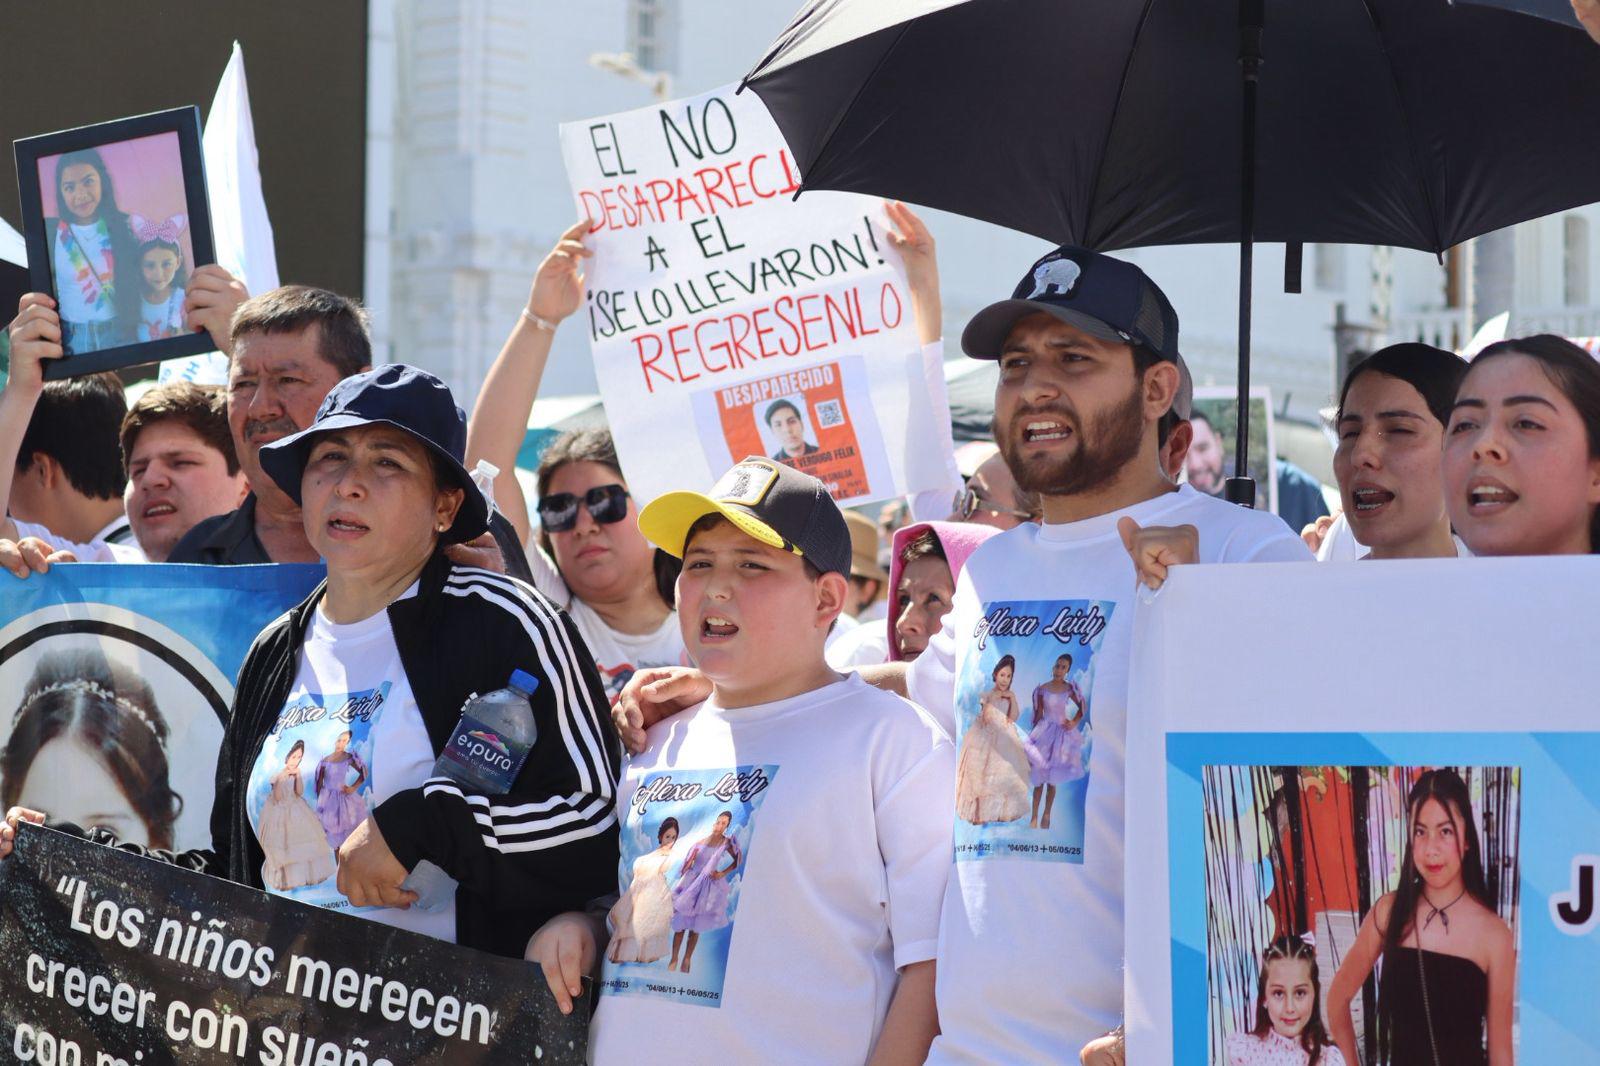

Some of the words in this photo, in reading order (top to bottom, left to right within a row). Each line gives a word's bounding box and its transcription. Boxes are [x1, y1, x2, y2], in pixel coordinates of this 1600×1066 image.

[589, 122, 637, 178] EL
[659, 97, 737, 168] NO
[579, 148, 801, 235] DESAPARECI
[643, 235, 669, 273] A
[690, 214, 746, 259] EL
[630, 282, 902, 393] REGRESENLO
[722, 365, 835, 410] DESAPARECIDO
[974, 606, 1039, 651] Alexa
[1043, 605, 1107, 645] Leidy
[632, 775, 702, 815] Alexa
[704, 768, 769, 803] Leidy
[26, 953, 156, 1029] crecer
[166, 1000, 248, 1058] con
[259, 1026, 394, 1066] sueñ
[153, 910, 275, 987] niños
[286, 954, 490, 1045] merecen
[13, 1022, 82, 1066] con
